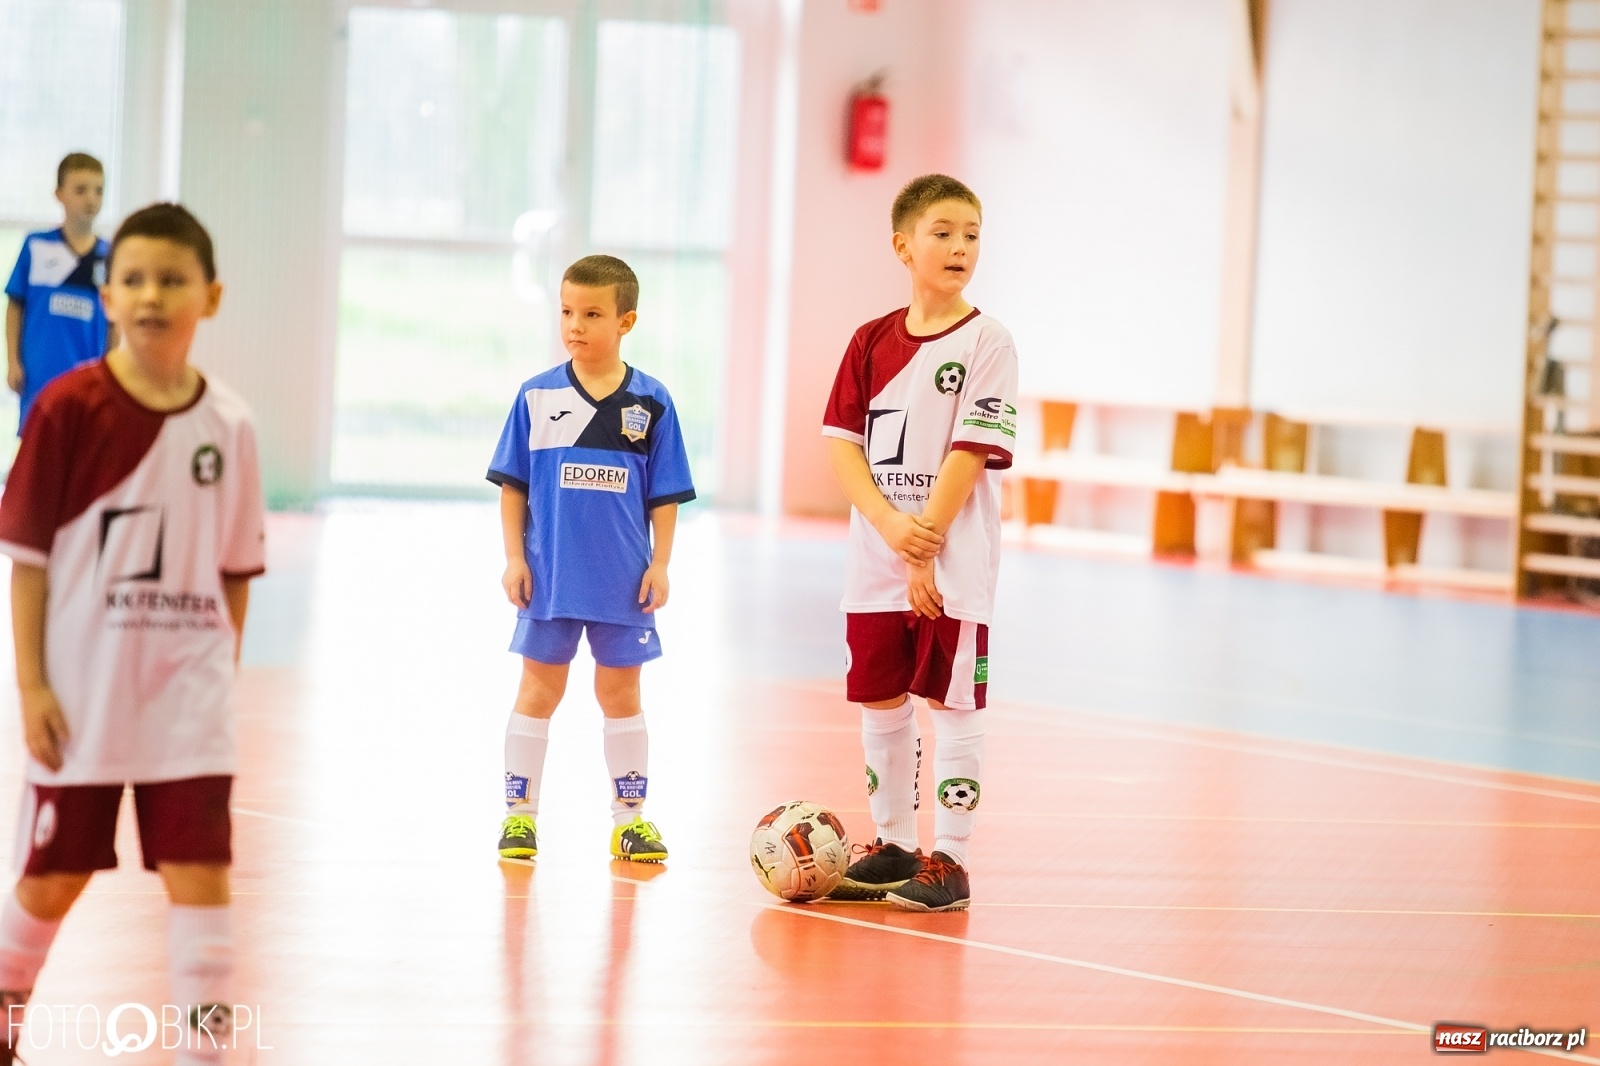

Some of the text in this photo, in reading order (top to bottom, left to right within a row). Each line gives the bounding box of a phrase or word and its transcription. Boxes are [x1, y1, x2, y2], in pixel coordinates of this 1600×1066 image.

[628, 422, 642, 431] GOL
[564, 466, 626, 484] EDOREM
[887, 473, 938, 488] FENST
[505, 789, 520, 798] OL
[622, 789, 642, 798] GOL
